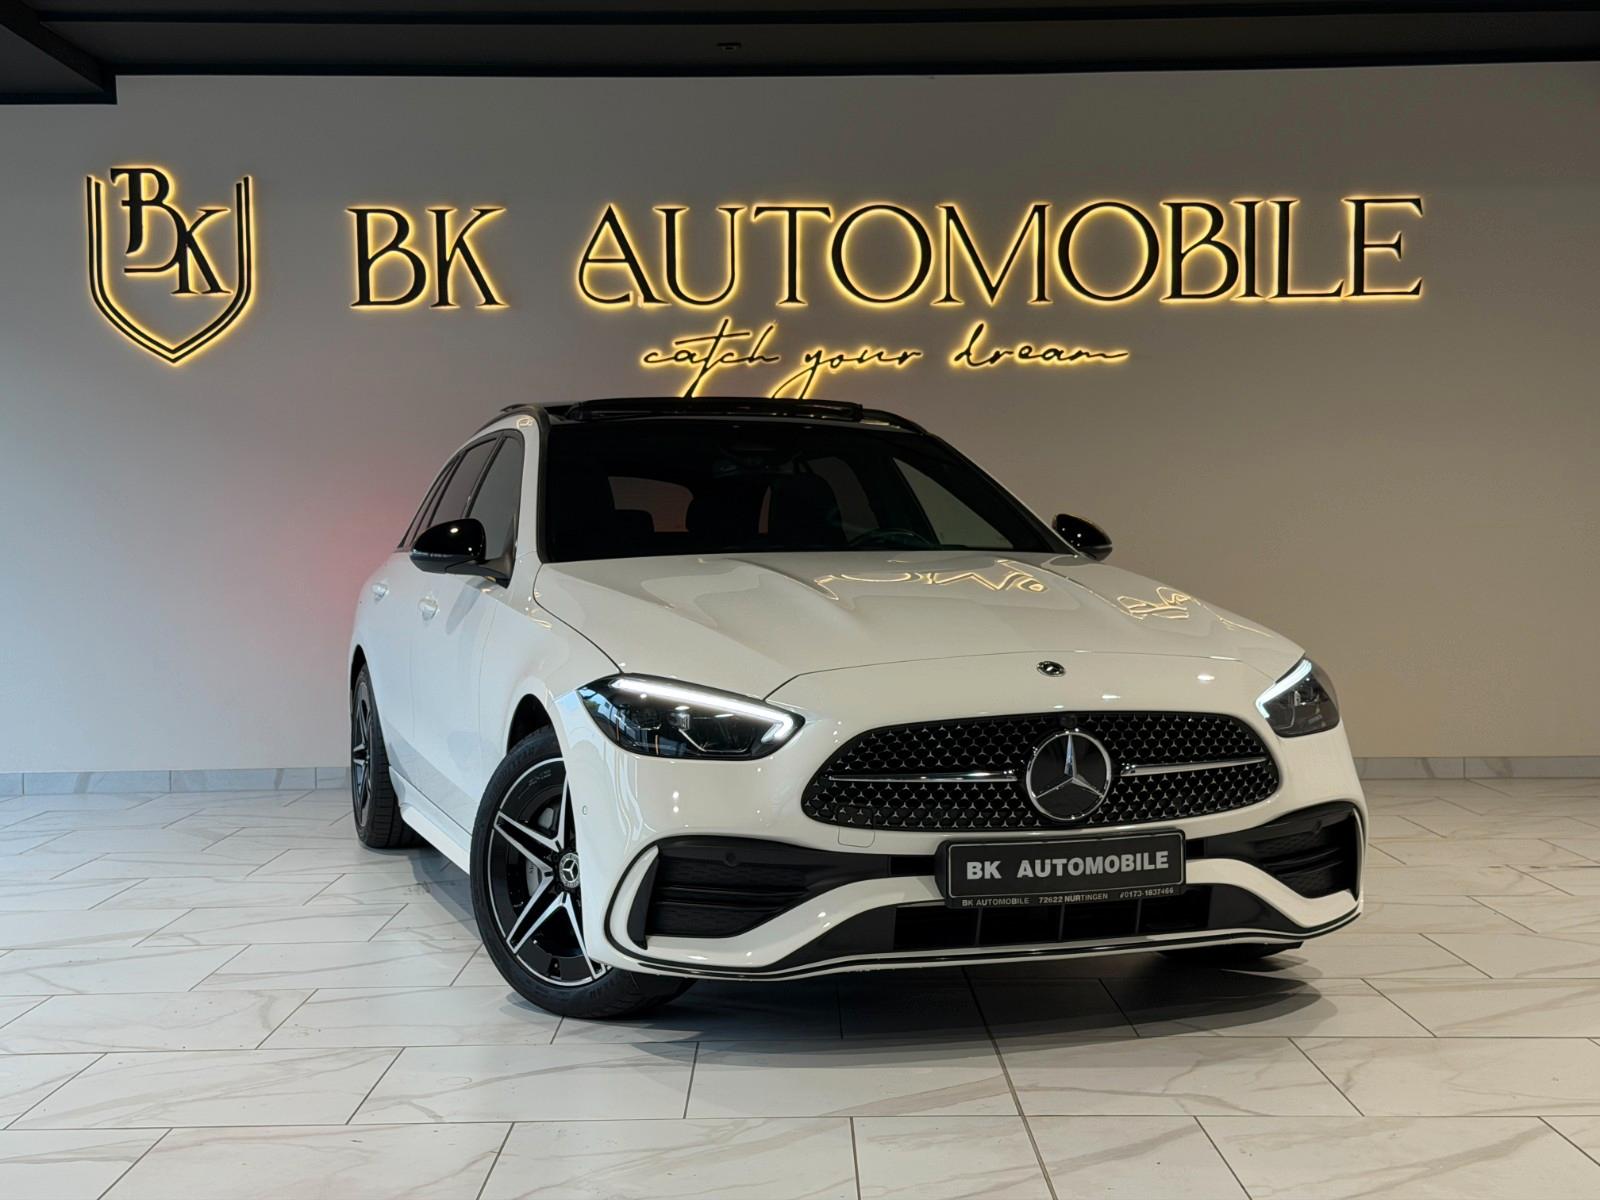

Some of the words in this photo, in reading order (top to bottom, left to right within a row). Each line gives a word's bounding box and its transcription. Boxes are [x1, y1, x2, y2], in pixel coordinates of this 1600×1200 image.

[110, 167, 232, 294] BK
[347, 208, 508, 307] BK
[577, 197, 1424, 307] AUTOMOBILE
[642, 319, 780, 397] catch
[772, 346, 923, 397] your
[954, 323, 1129, 365] dream
[962, 899, 974, 907] BK
[976, 898, 1030, 906] AUTOMOBILE
[1038, 896, 1063, 904] 72622
[966, 861, 1002, 880] BK
[1017, 851, 1169, 878] AUTOMOBILE
